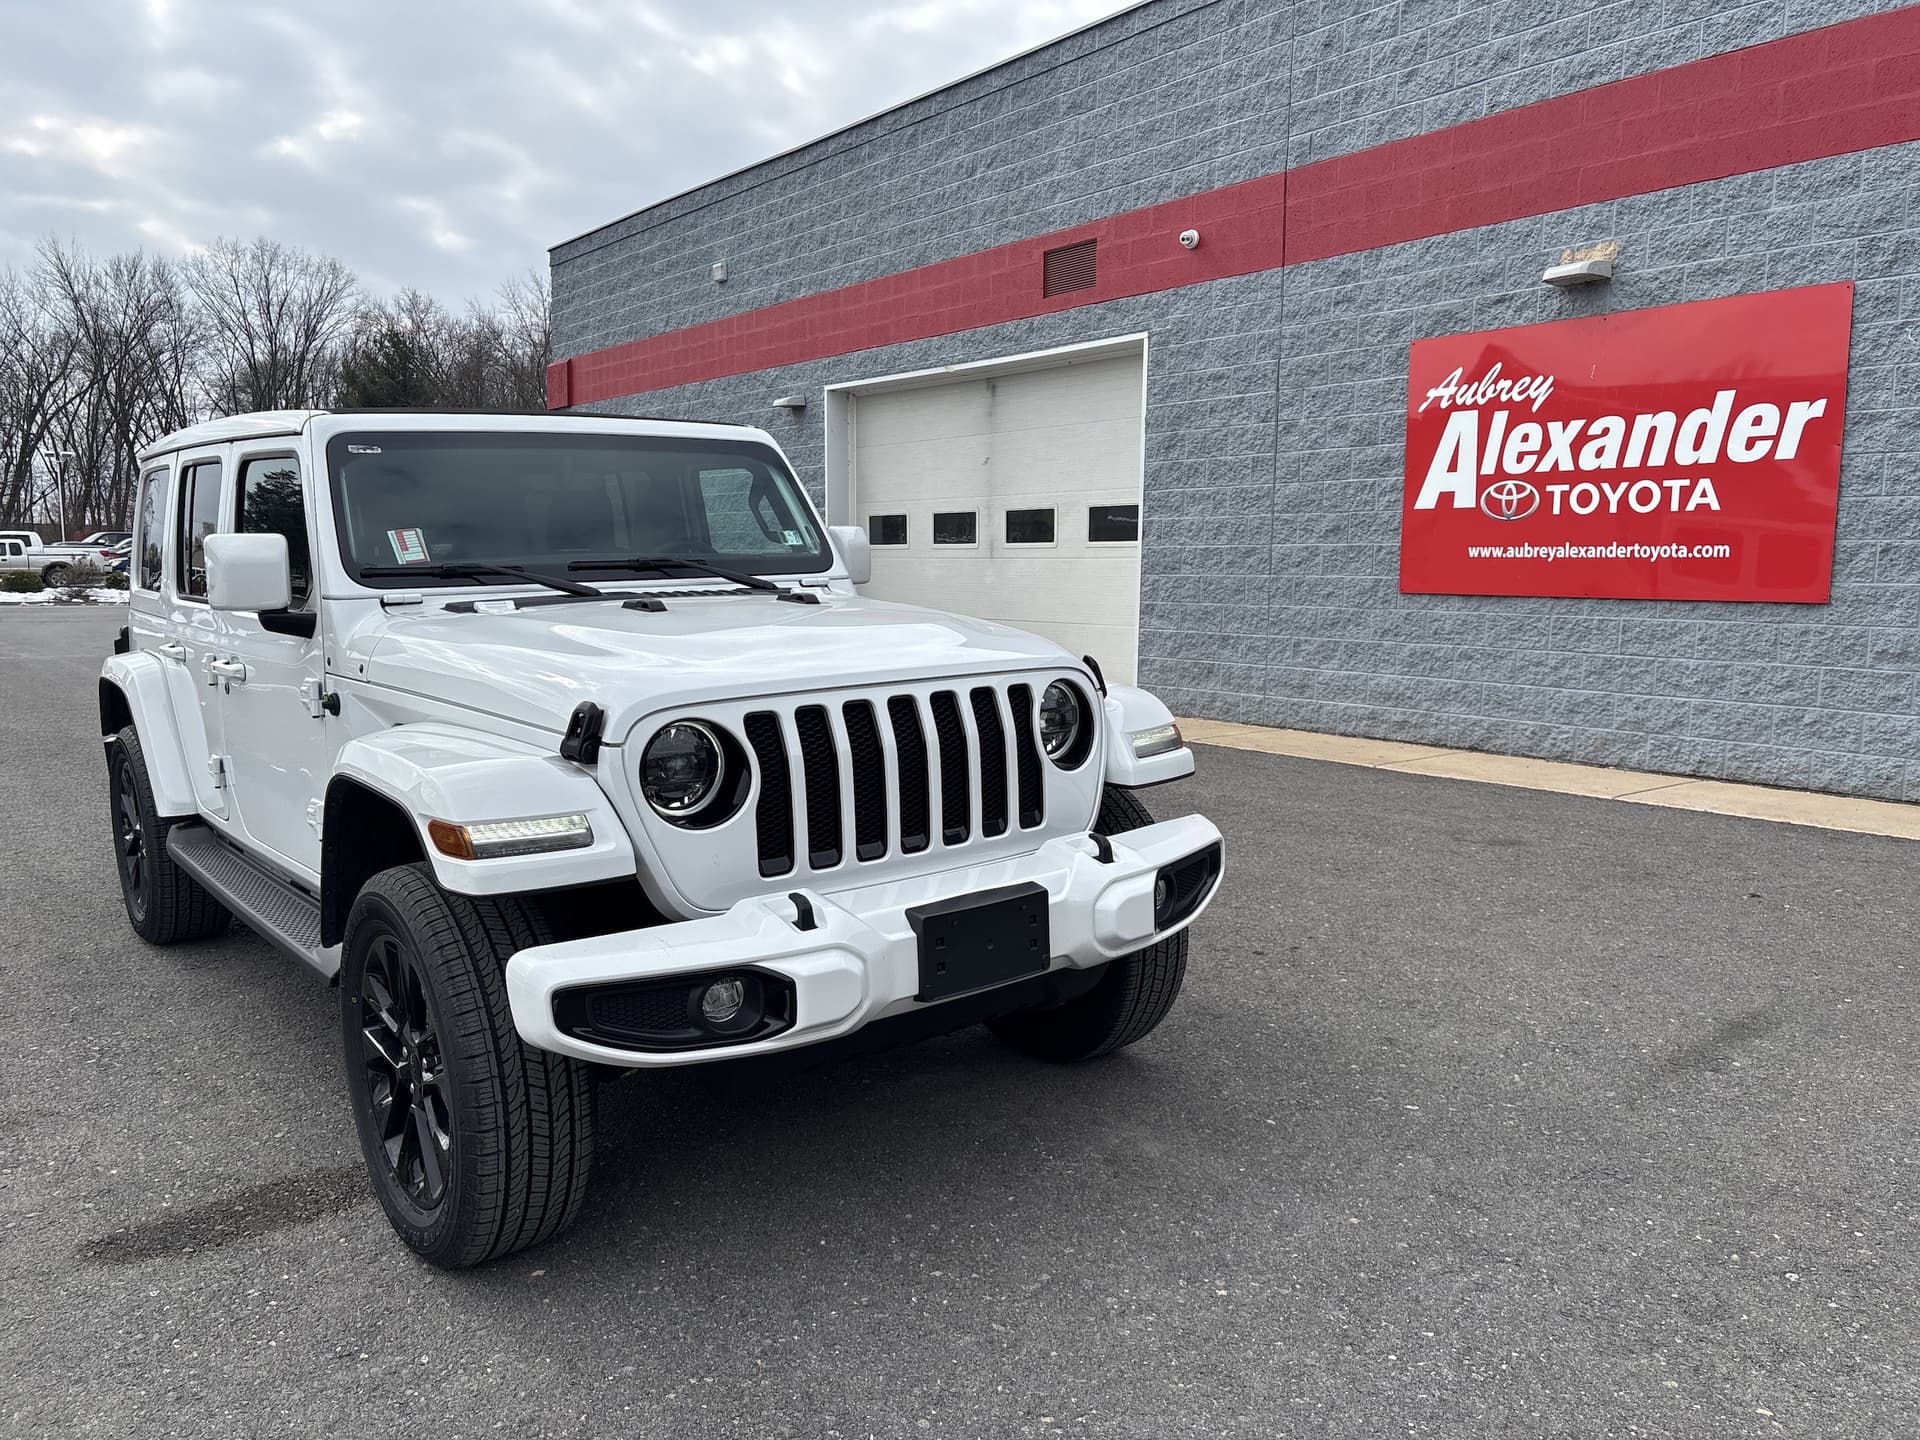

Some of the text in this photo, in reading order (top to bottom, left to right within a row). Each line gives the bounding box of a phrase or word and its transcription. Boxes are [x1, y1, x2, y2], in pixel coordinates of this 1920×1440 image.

[1418, 362, 1554, 413] Aubrey
[1413, 390, 1828, 510] Alexander
[1546, 478, 1721, 515] TOYOTA
[1468, 542, 1731, 562] www.aubreyalexandertoyota.com
